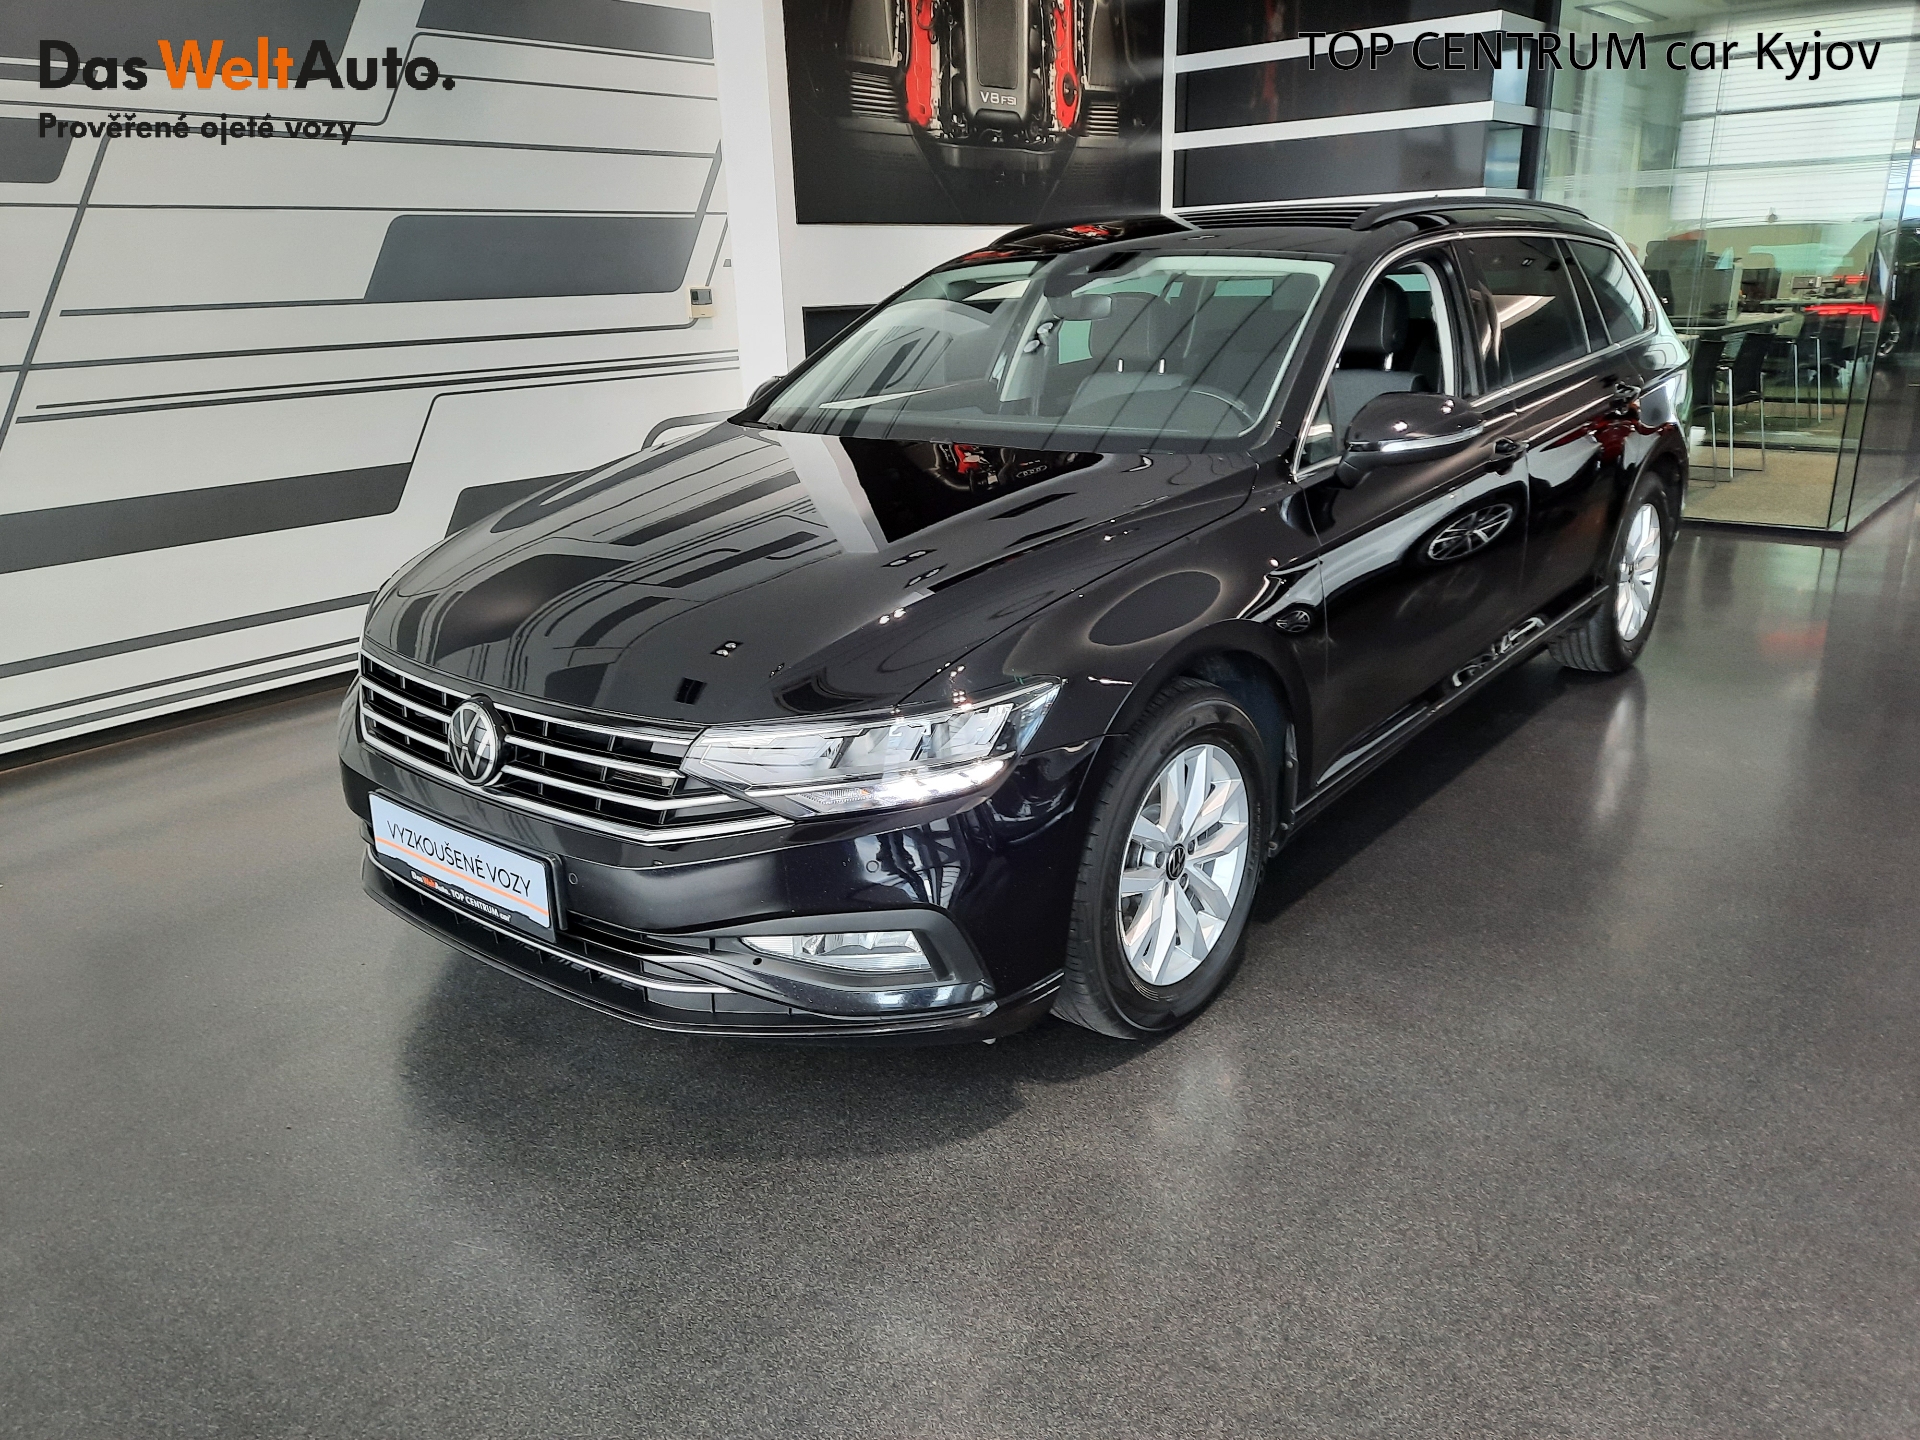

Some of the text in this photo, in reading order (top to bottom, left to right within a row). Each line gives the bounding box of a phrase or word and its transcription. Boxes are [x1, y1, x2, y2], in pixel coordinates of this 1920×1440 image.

[980, 91, 1000, 104] V8
[387, 820, 531, 897] VYZKOUŠENÉ VOZY
[450, 889, 464, 902] TOP
